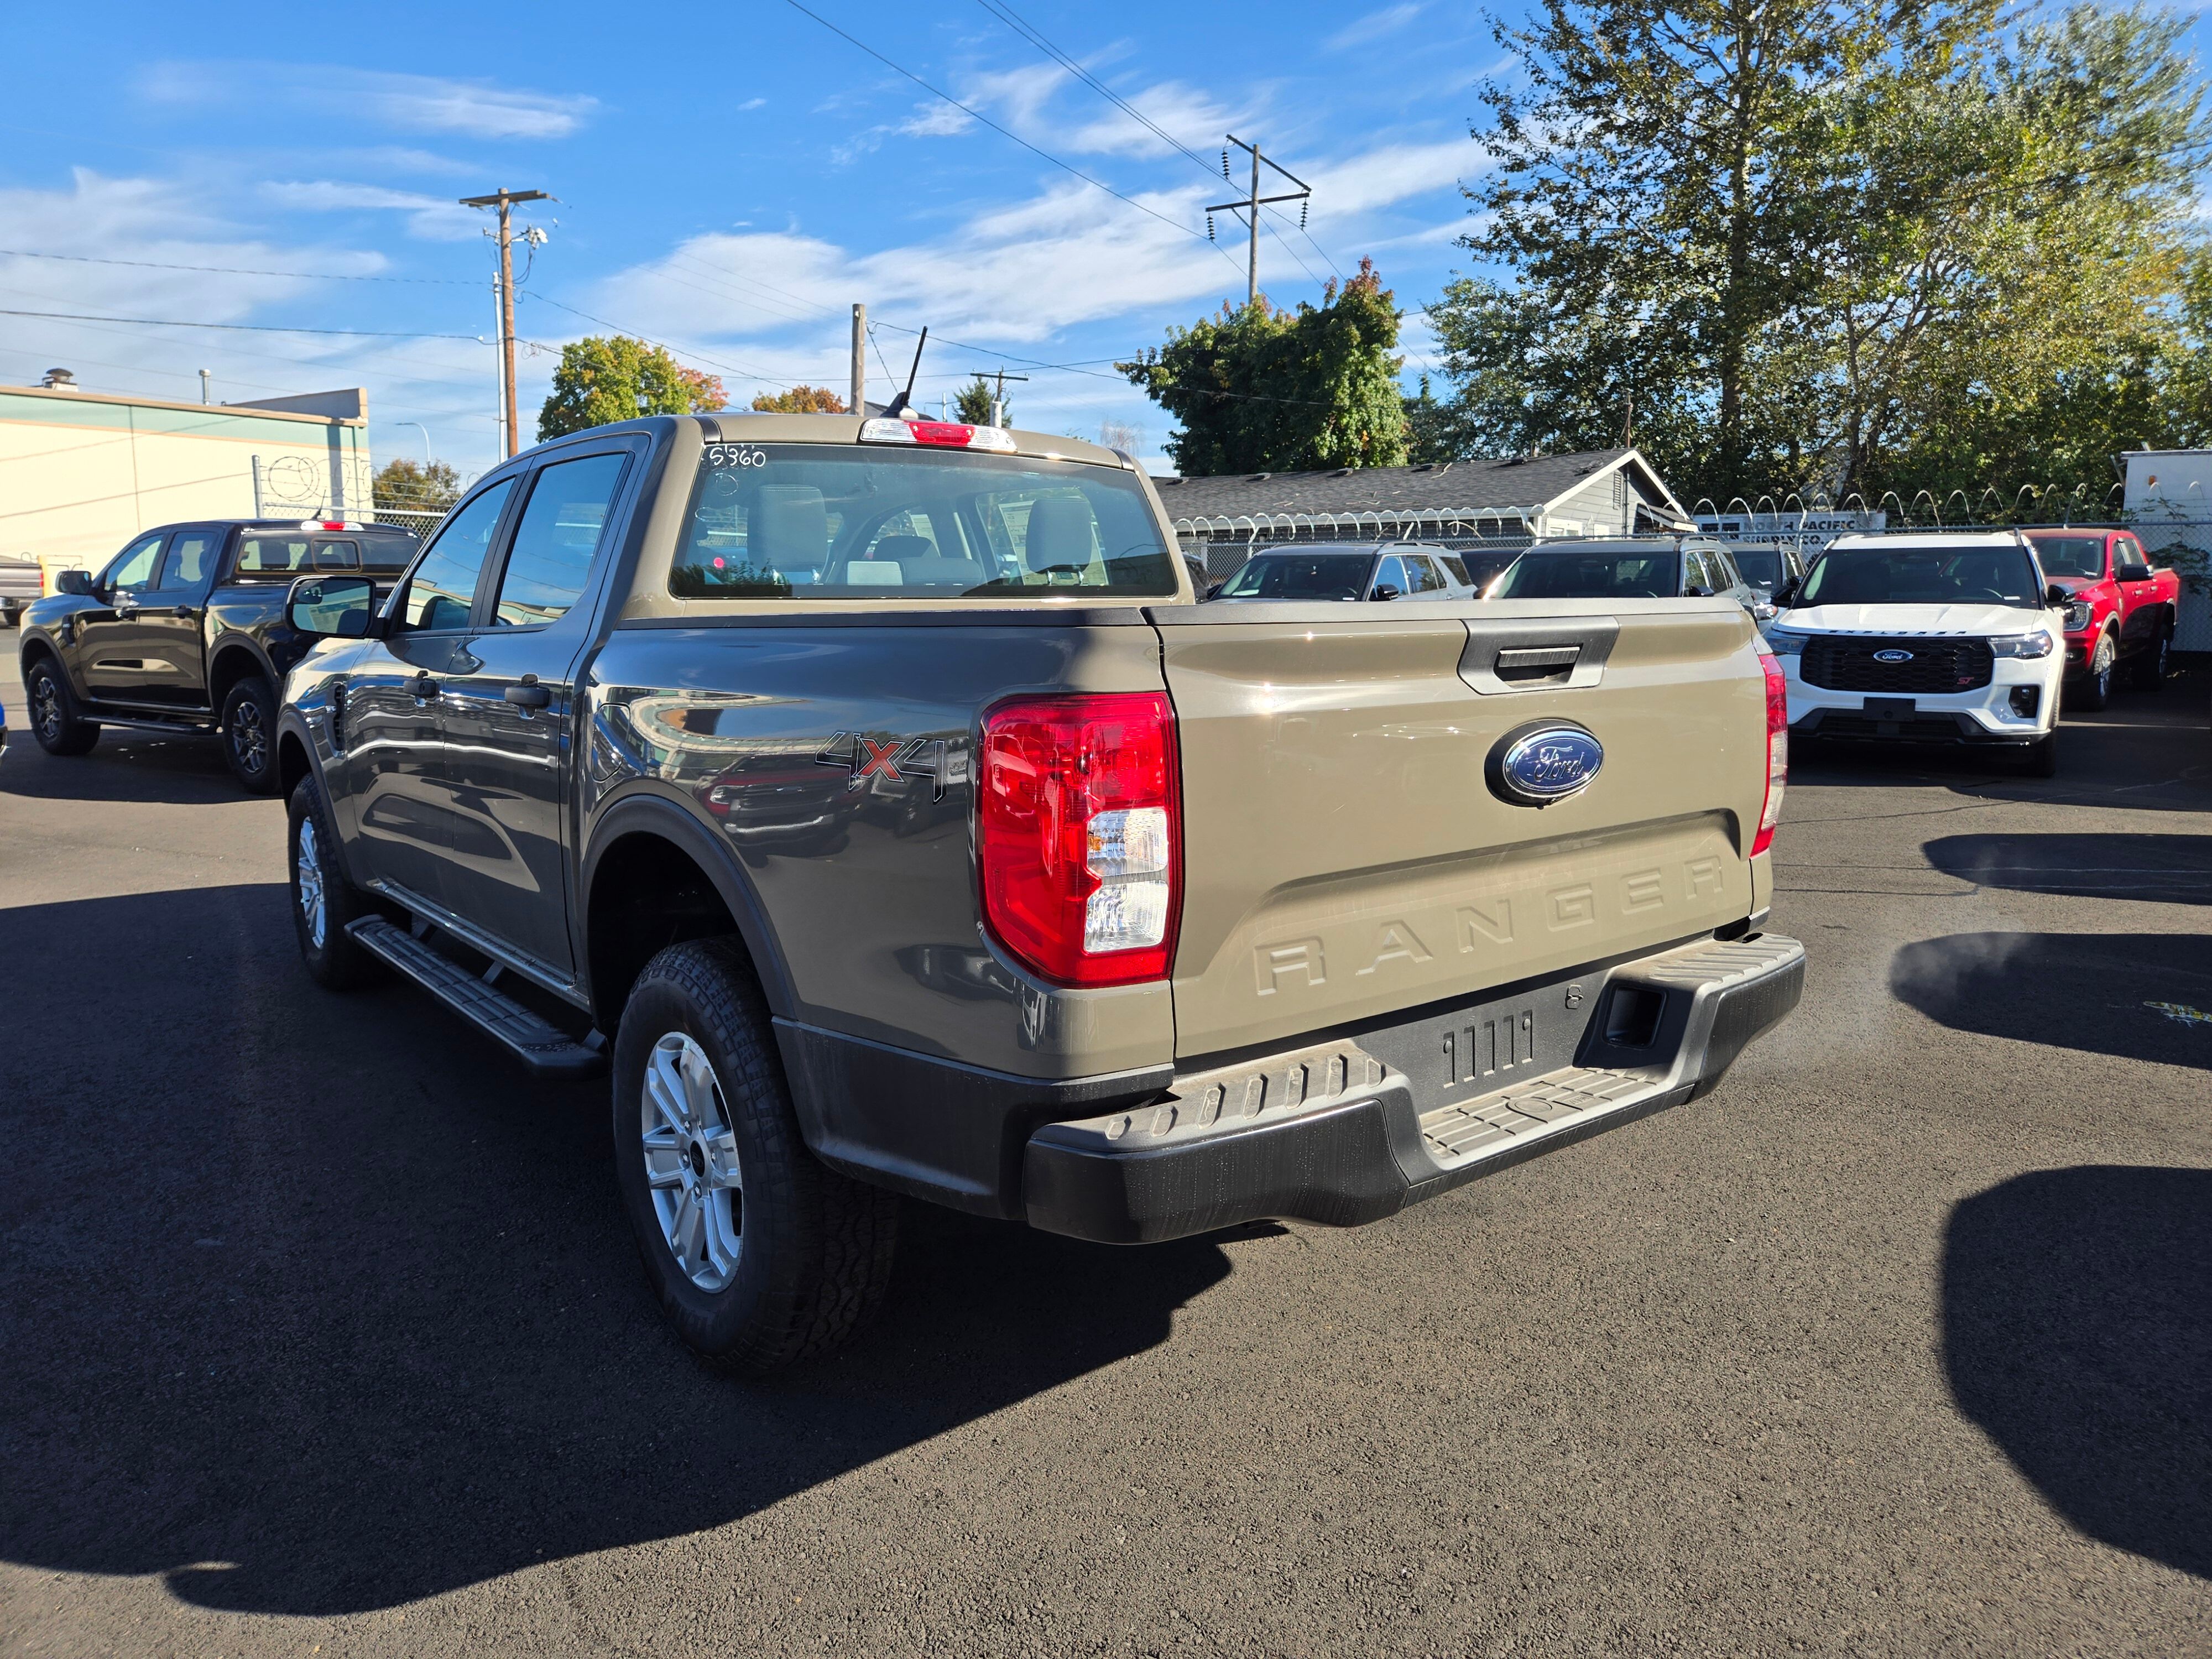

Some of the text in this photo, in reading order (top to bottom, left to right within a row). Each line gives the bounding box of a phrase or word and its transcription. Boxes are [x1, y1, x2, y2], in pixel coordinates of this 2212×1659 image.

[1744, 520, 1856, 531] NORTH PACIFIC
[1956, 676, 1975, 685] ST
[1532, 745, 1585, 782] Ford
[1254, 854, 1724, 995] RANGER
